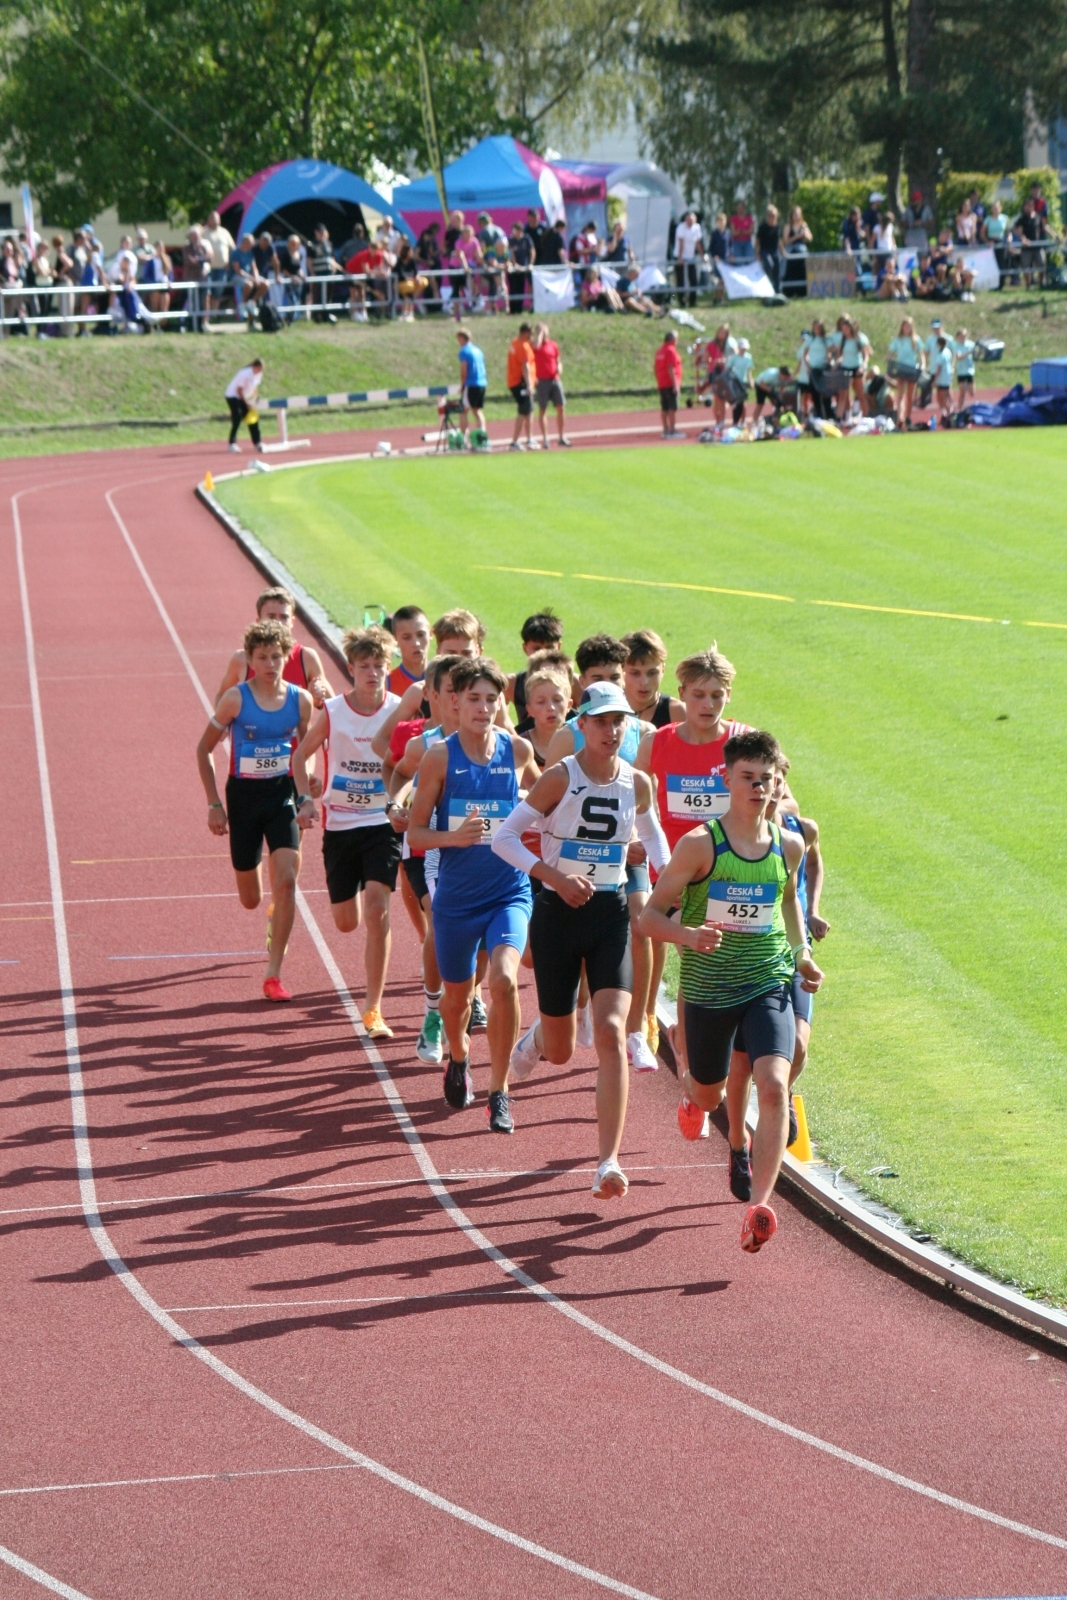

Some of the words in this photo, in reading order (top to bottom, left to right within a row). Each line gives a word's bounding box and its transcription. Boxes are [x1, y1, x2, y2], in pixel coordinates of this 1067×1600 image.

[255, 758, 278, 769] 586
[347, 765, 382, 773] OPAVA
[349, 760, 382, 768] SOKOL
[680, 778, 706, 787] ČESKÁ
[346, 793, 371, 804] 525
[683, 794, 712, 807] 463
[576, 796, 619, 840] S
[578, 846, 602, 856] ČESKÁ
[586, 863, 596, 876] 2
[726, 885, 753, 896] ČESKÁ
[727, 904, 759, 918] 452
